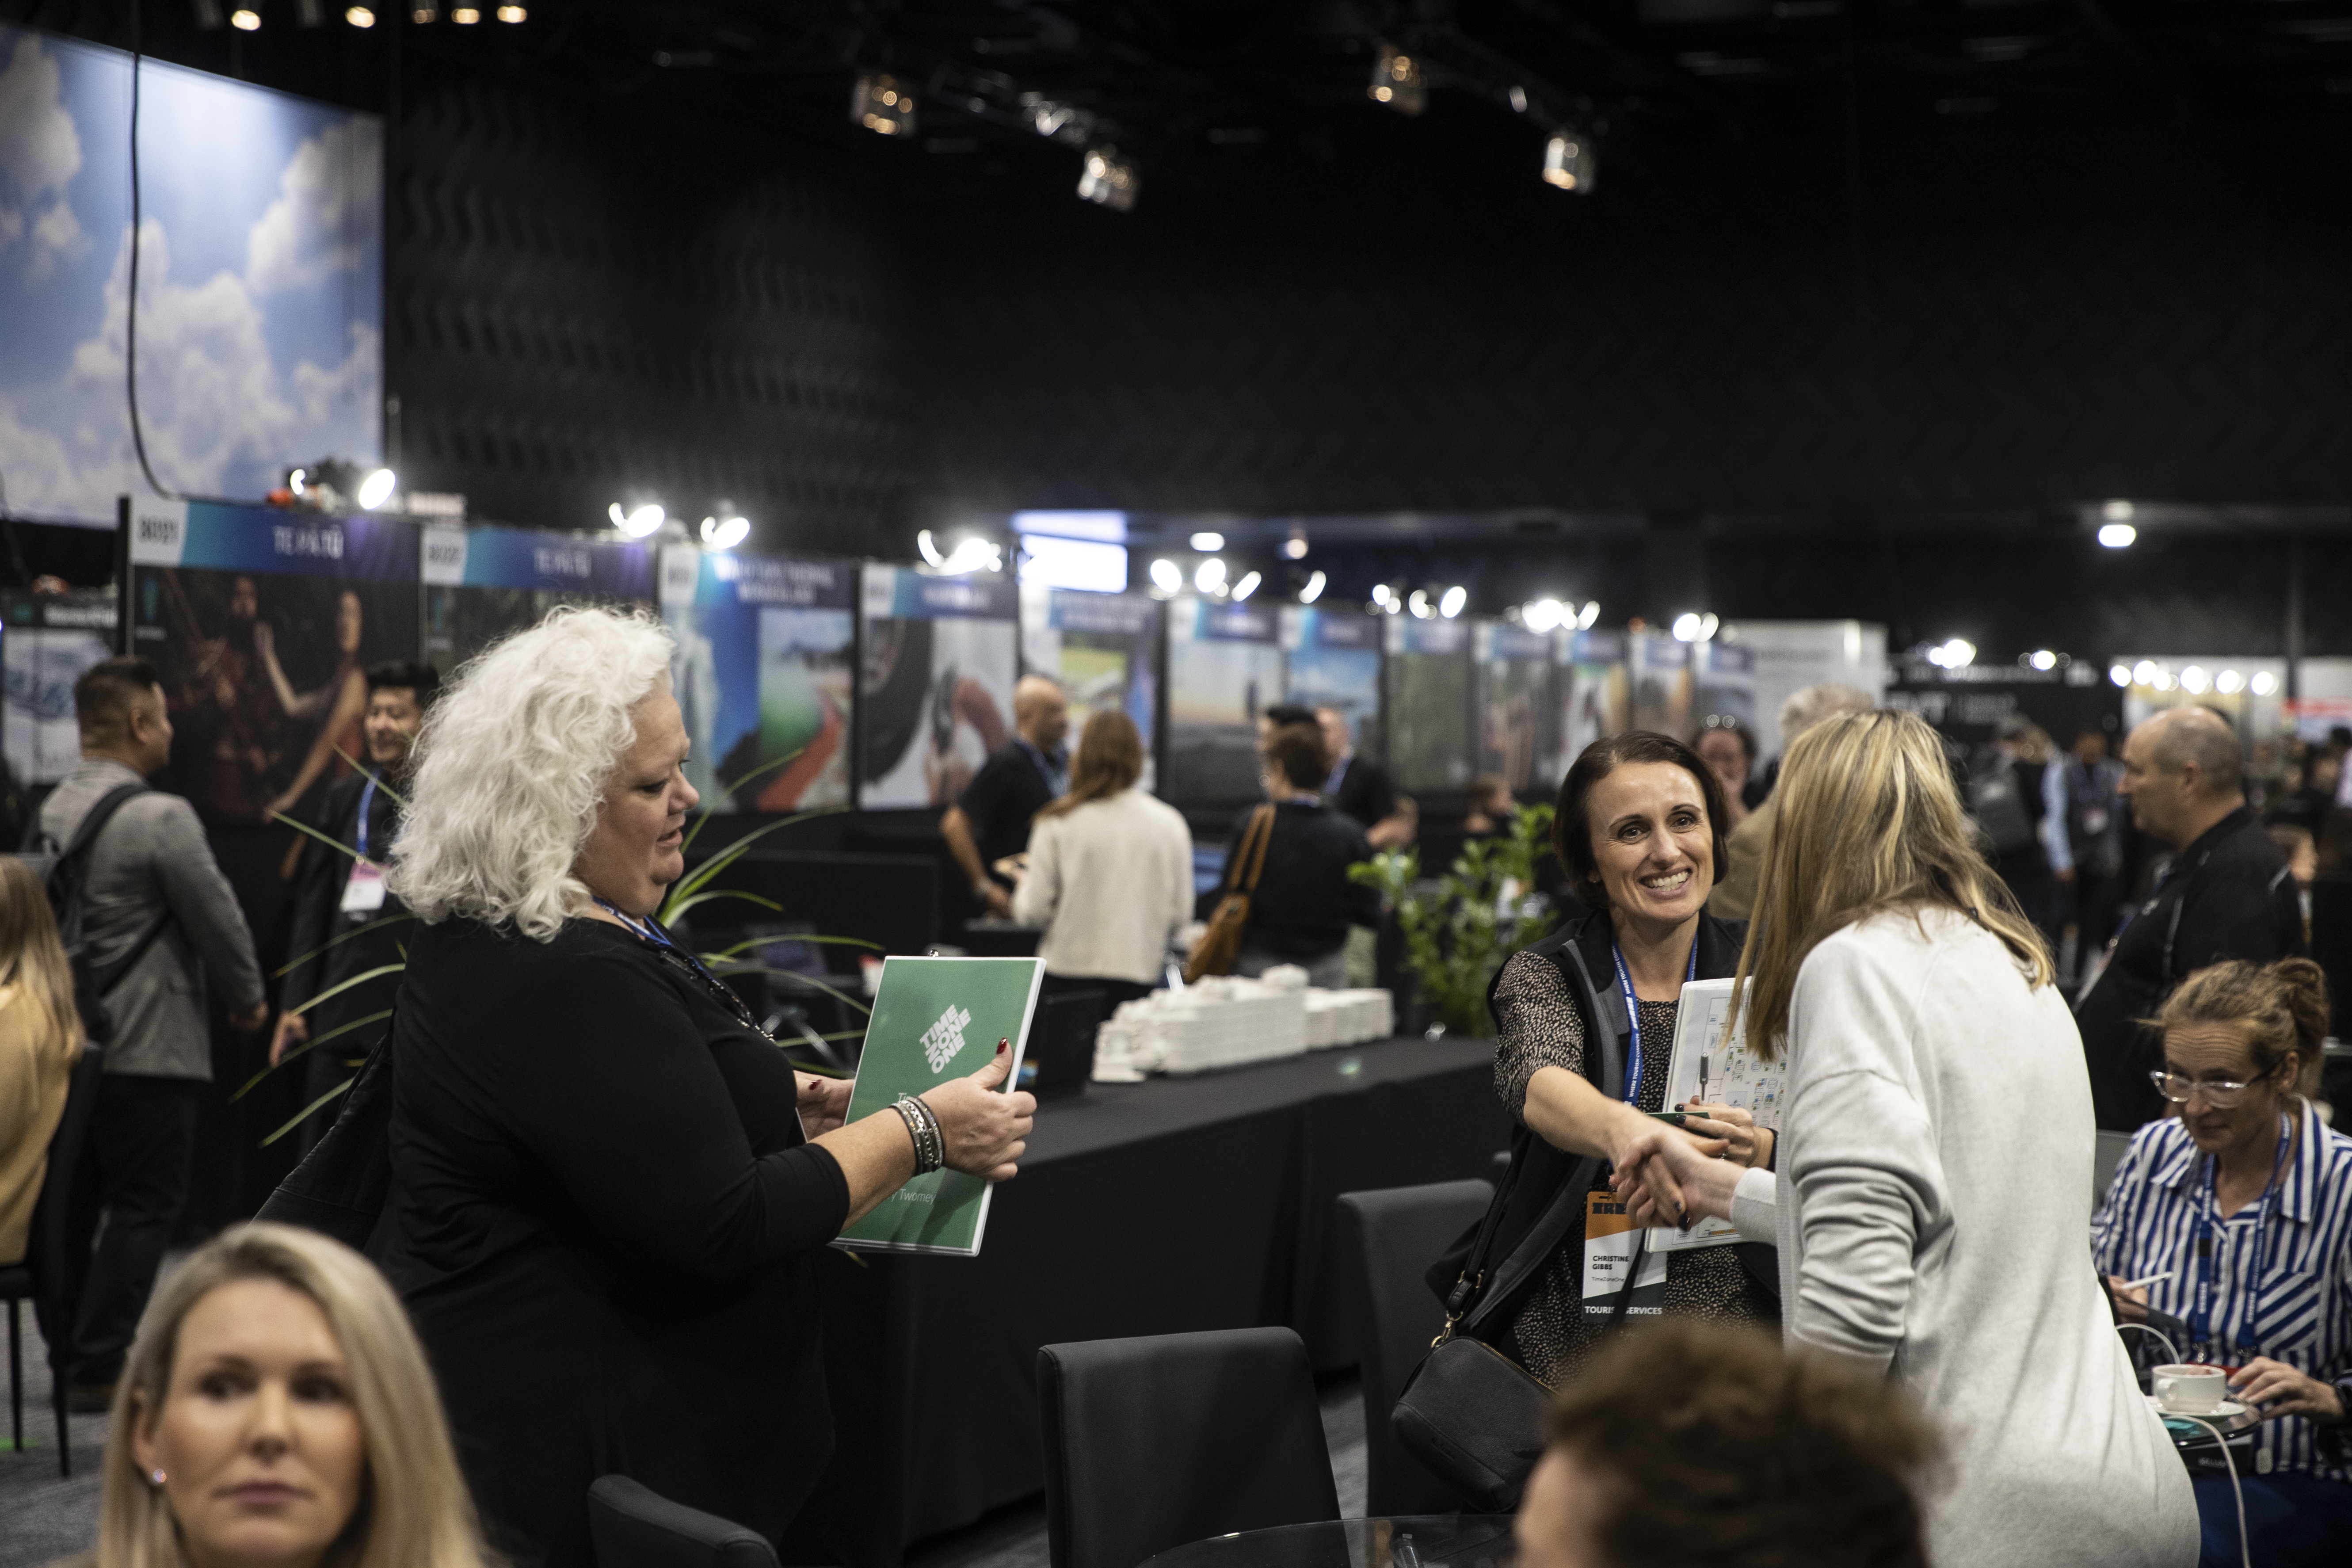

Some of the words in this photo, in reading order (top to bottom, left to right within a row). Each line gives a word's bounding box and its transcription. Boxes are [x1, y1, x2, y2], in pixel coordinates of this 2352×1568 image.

[1616, 961, 1627, 980] TOURISM
[1623, 980, 1632, 994] WHERE
[919, 1004, 959, 1049] TIME
[925, 1008, 972, 1064] ZONE
[931, 1032, 966, 1074] ONE
[1629, 1080, 1637, 1097] WHERE
[899, 1188, 937, 1206] Twomey
[1585, 1305, 1615, 1314] TOURIS
